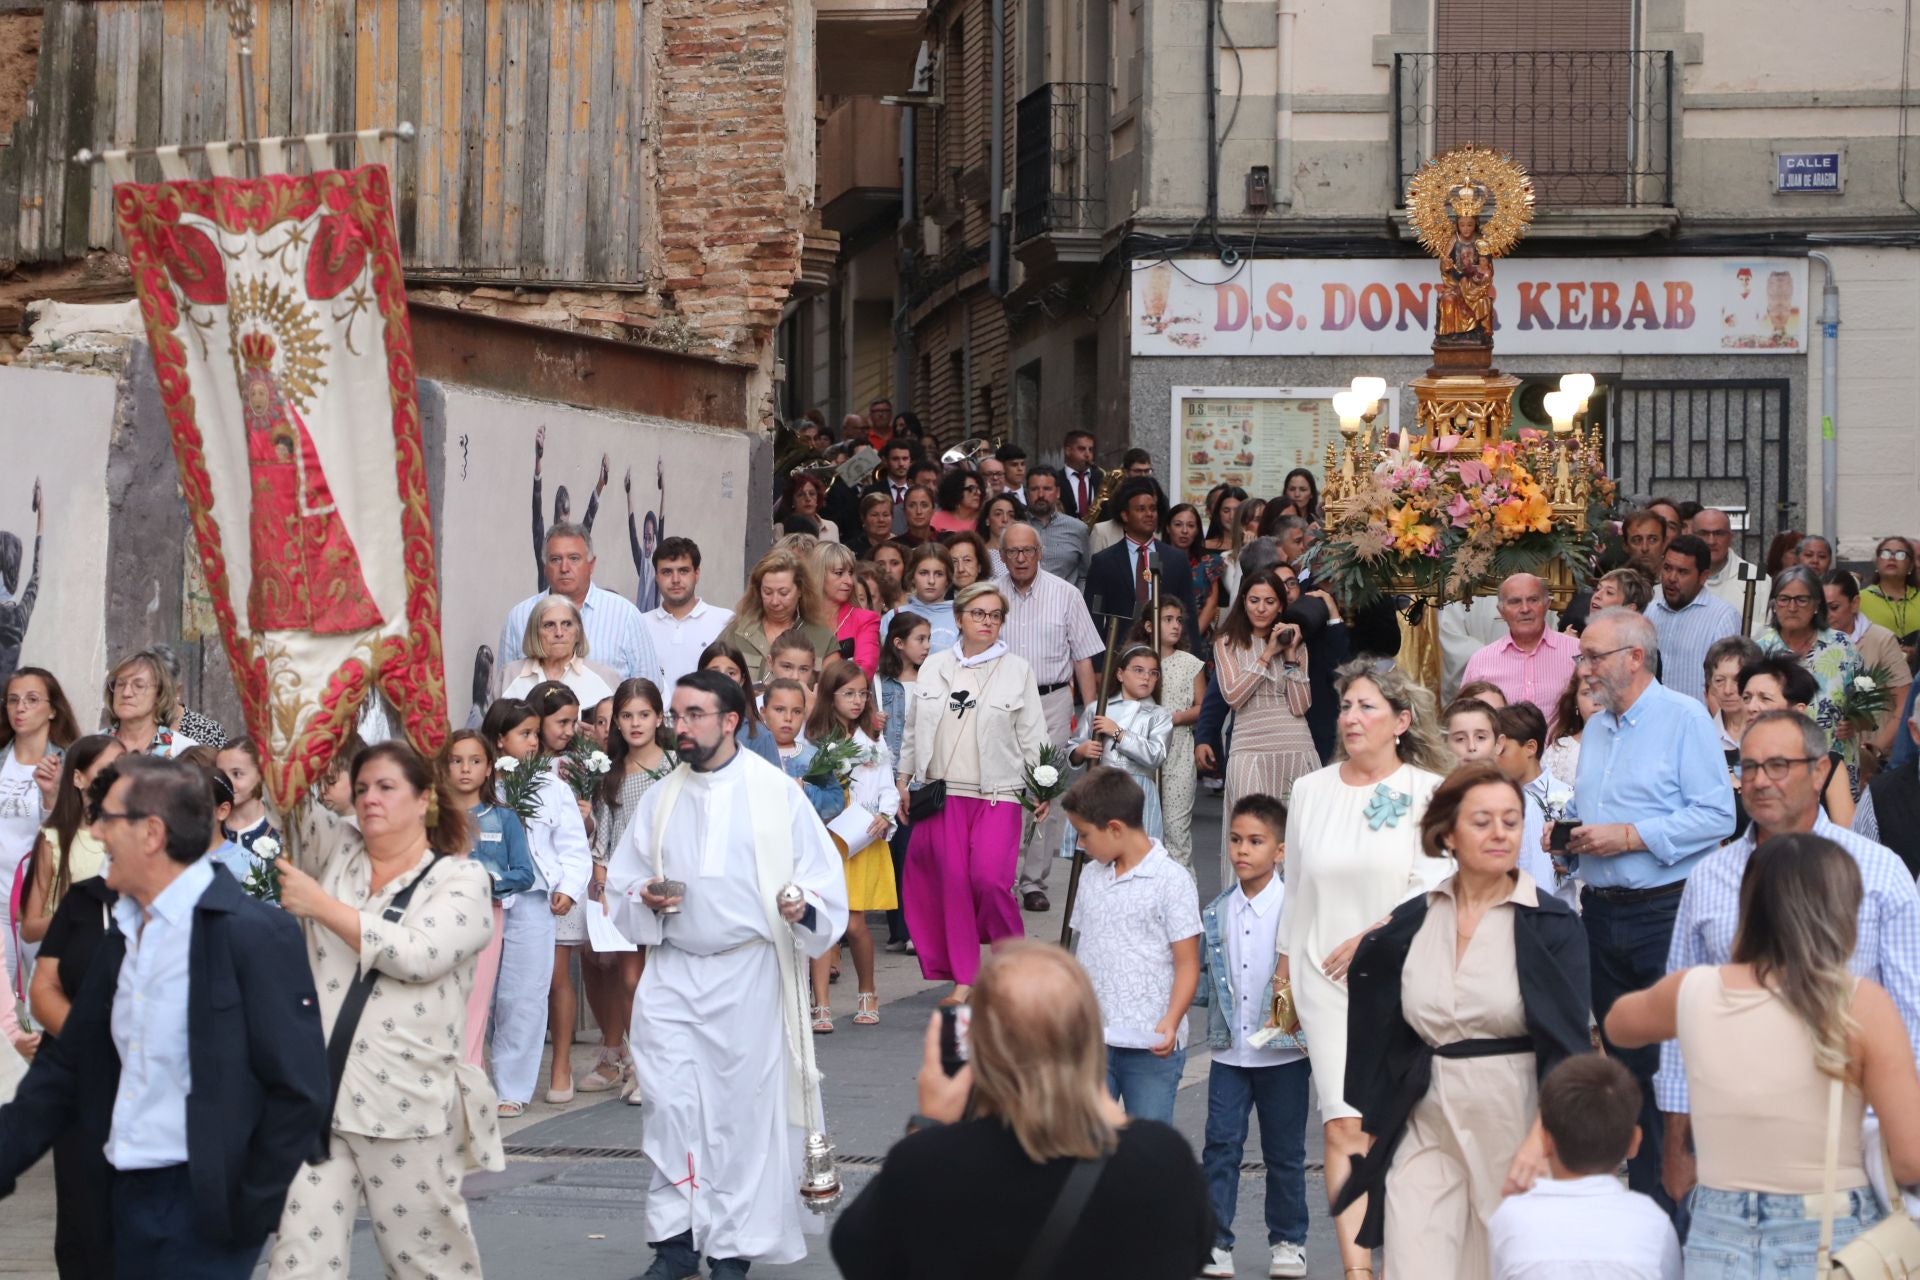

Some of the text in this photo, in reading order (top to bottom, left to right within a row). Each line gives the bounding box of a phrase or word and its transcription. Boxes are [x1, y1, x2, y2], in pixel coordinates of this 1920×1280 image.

[1786, 158, 1831, 168] CALLE
[1786, 173, 1803, 187] JUAN
[1803, 174, 1812, 187] DE
[1214, 281, 1697, 332] D.S. DON KEBAB
